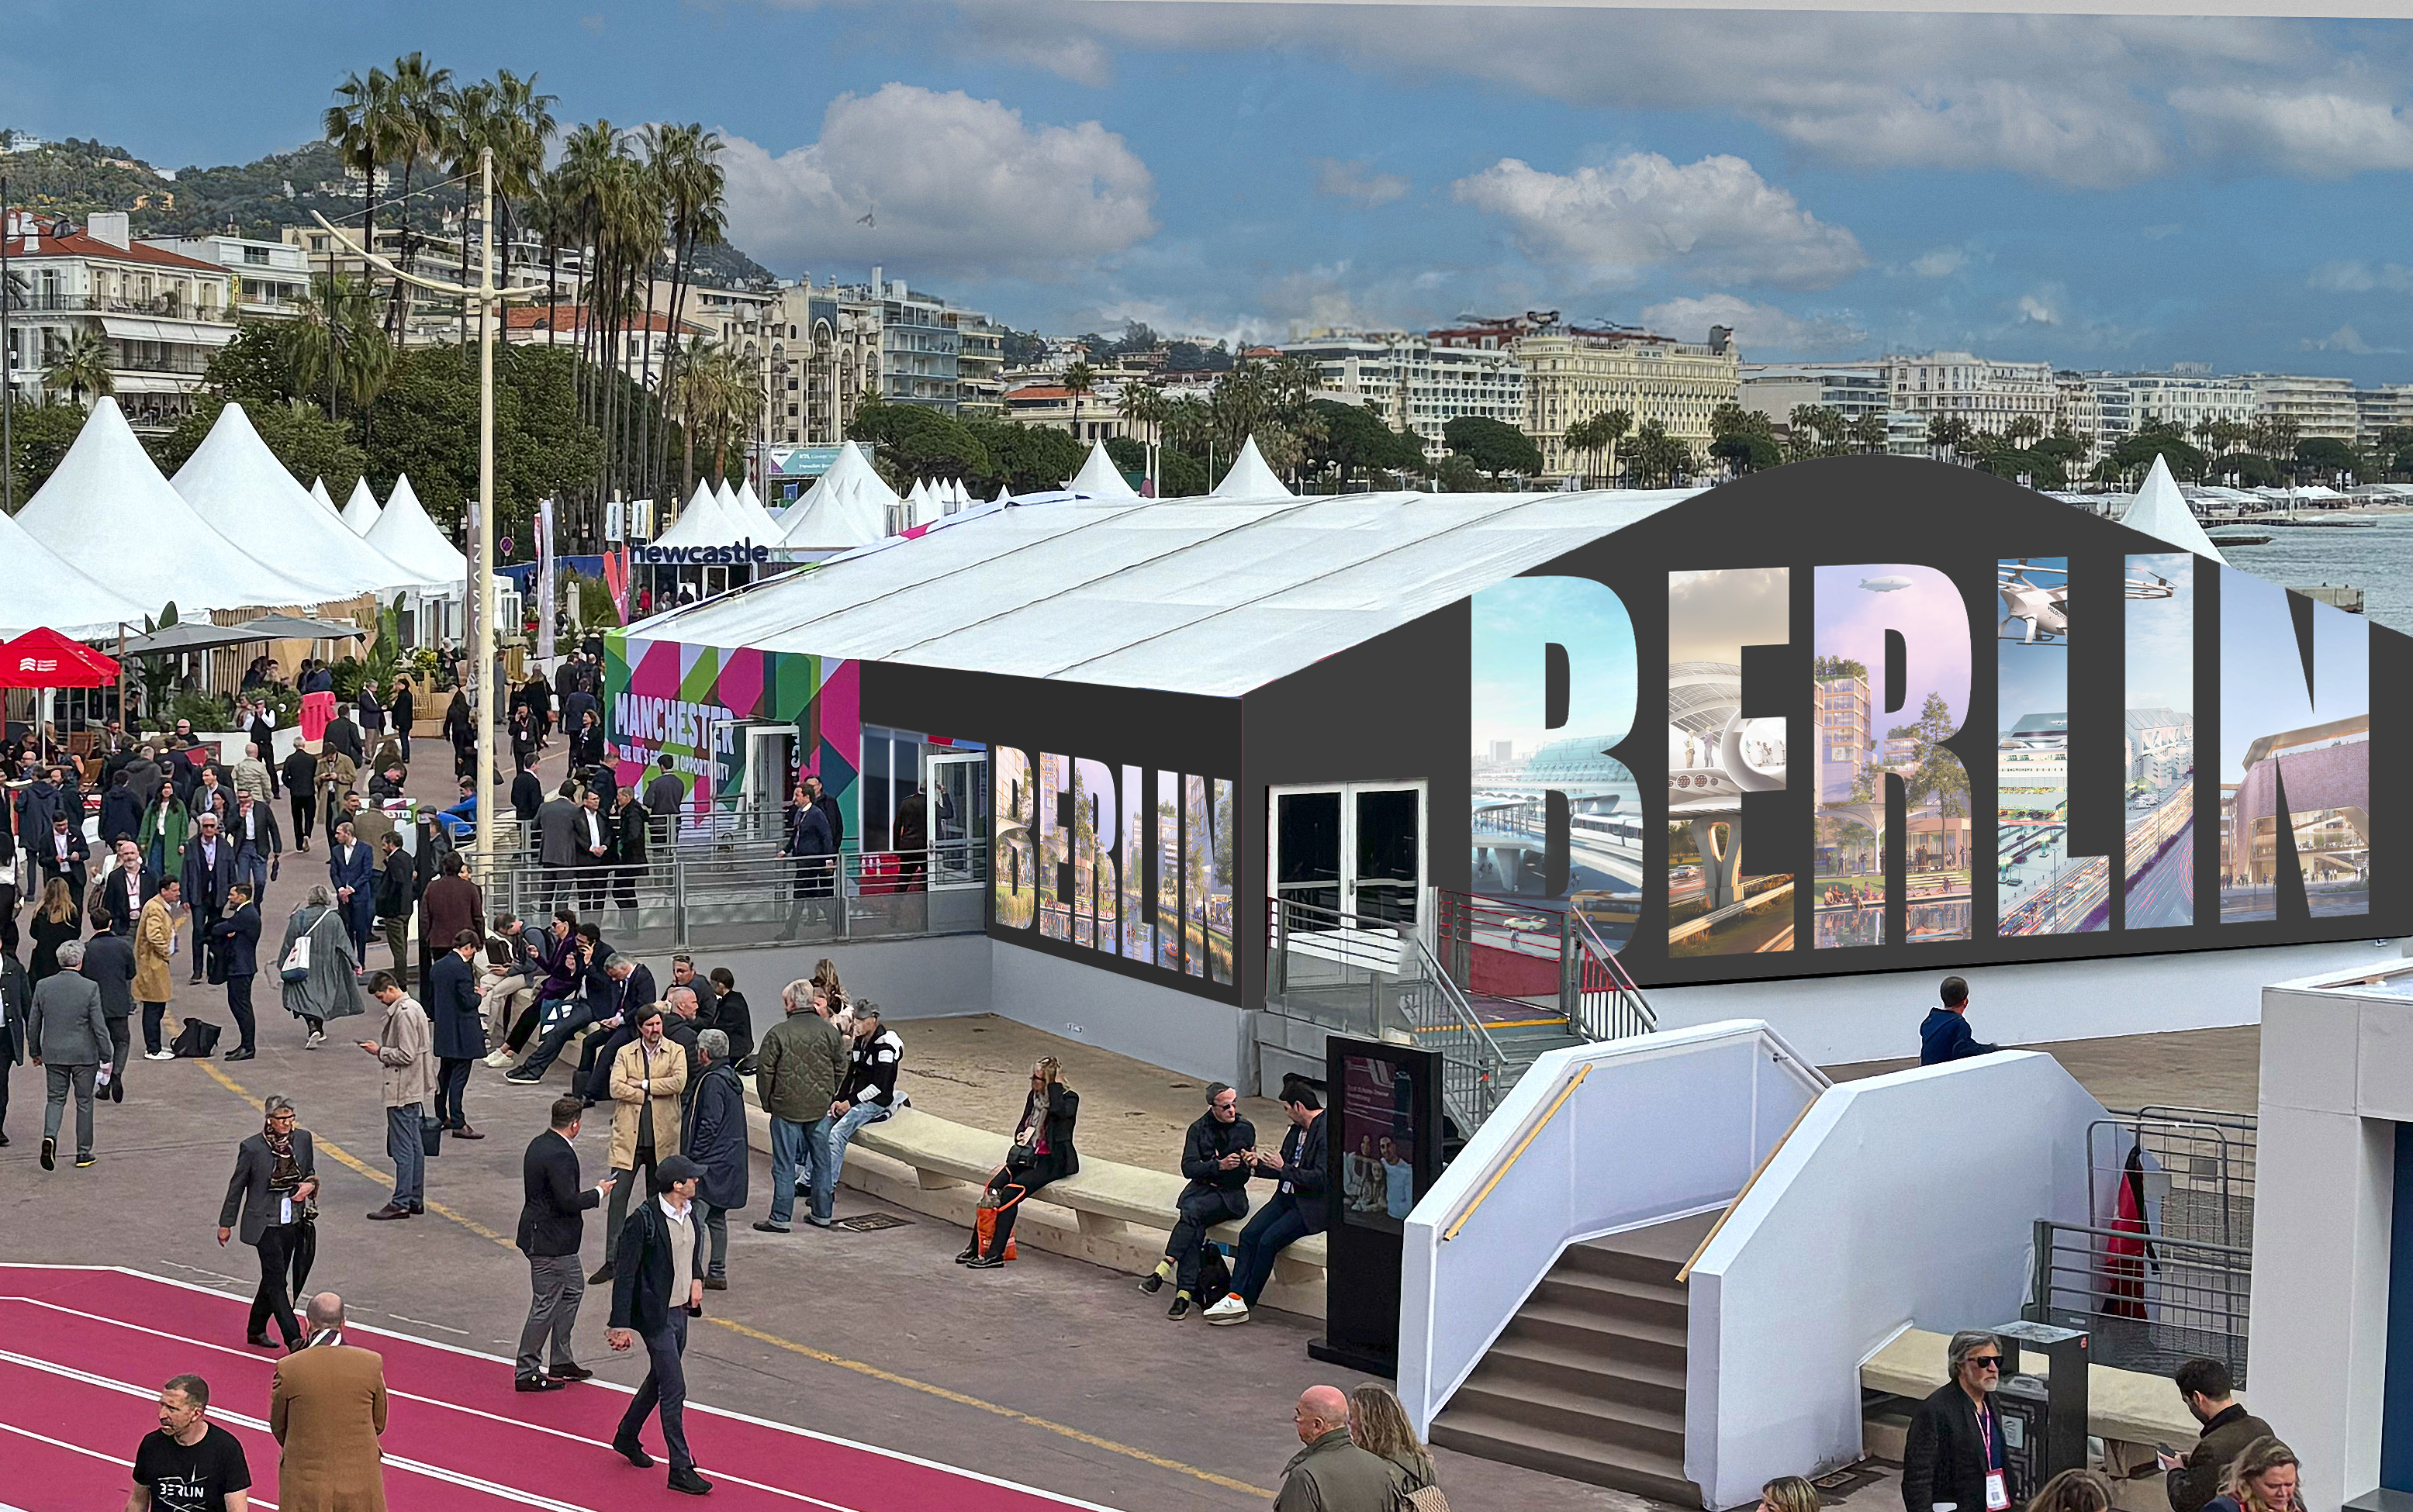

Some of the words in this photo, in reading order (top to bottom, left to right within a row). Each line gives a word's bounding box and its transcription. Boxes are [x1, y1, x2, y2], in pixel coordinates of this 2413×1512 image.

[631, 537, 769, 563] newcastle
[615, 692, 735, 755] MANCHESTER
[1471, 552, 2370, 959] BERLIN
[995, 744, 1233, 986] BERLIN
[160, 1483, 204, 1498] BERLIN
